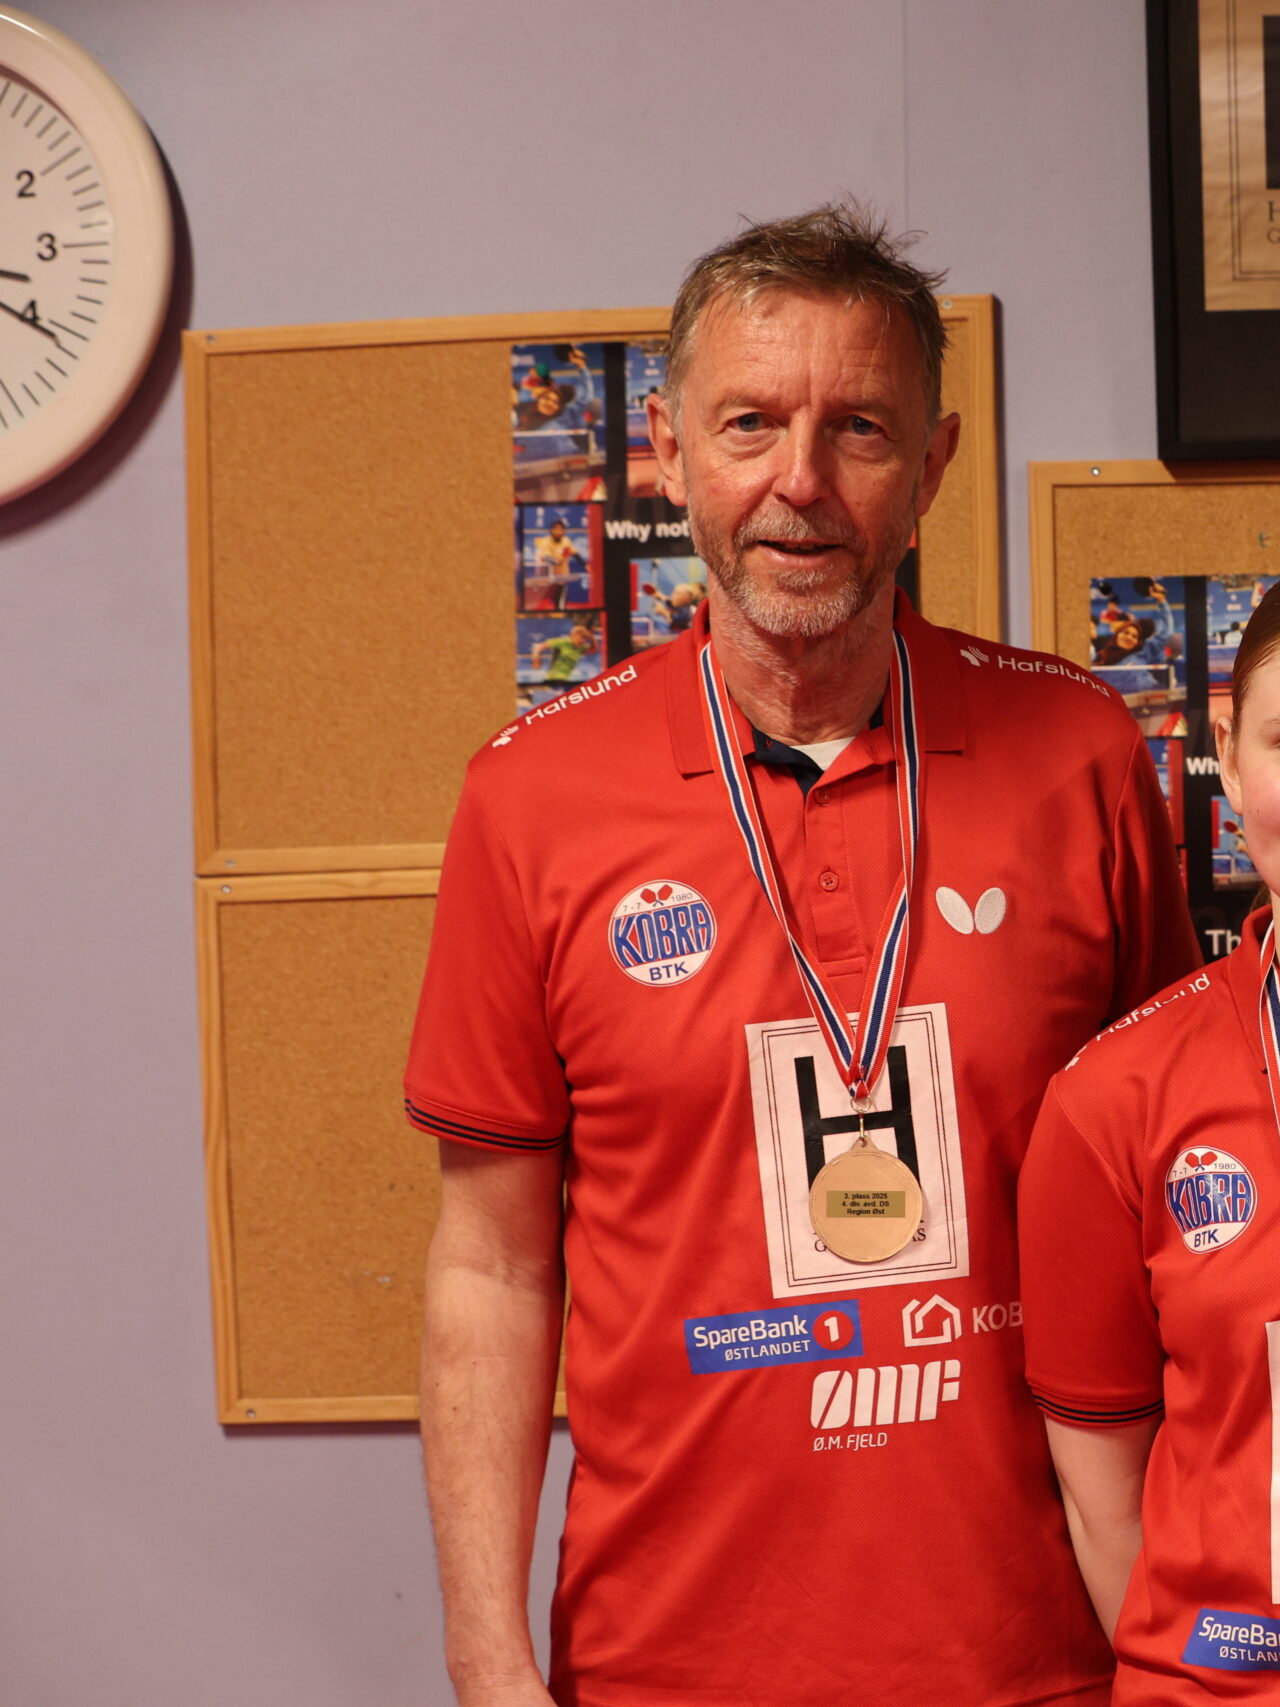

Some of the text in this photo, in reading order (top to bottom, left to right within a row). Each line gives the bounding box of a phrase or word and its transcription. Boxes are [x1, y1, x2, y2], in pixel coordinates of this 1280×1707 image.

[15, 169, 36, 198] 2
[36, 232, 58, 262] 3
[605, 520, 690, 543] Why not
[997, 655, 1110, 698] Hafslund
[525, 665, 637, 725] Hafslund
[671, 891, 693, 903] 1980
[613, 901, 712, 968] KOBRA
[649, 961, 689, 981] BTK
[1214, 1162, 1236, 1171] 1980
[847, 1208, 871, 1216] Region
[1168, 1173, 1252, 1233] KOBRA
[1194, 1228, 1219, 1248] BTK
[694, 1315, 808, 1349] SpareBank
[725, 1340, 810, 1361] ØSTLANDET
[813, 1432, 888, 1452] Ø.M. FJELD
